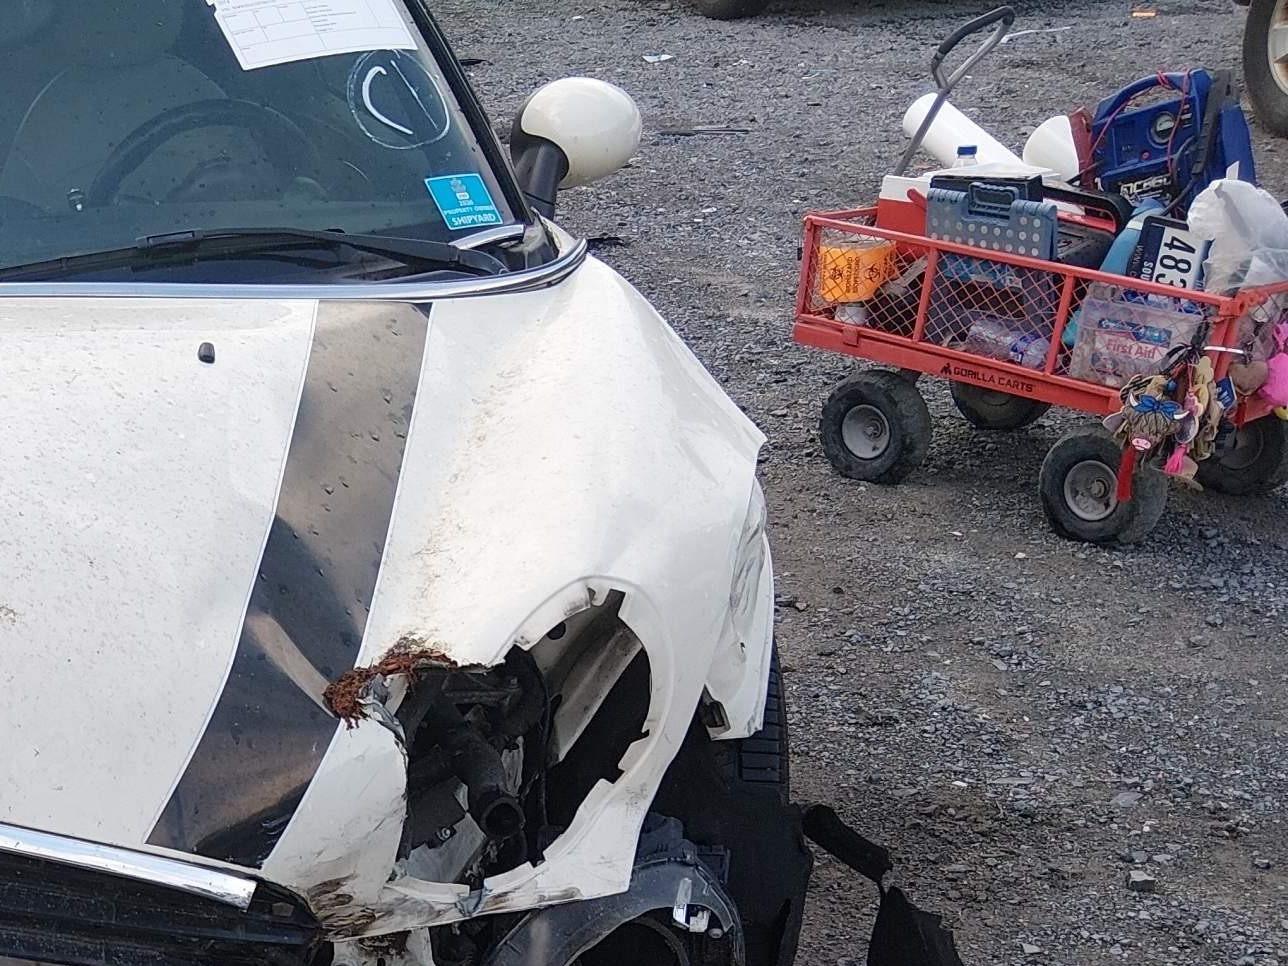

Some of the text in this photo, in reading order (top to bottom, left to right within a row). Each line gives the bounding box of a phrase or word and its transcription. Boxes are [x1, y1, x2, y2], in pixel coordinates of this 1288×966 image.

[452, 213, 496, 226] SHIPYARD
[1106, 340, 1156, 359] First Aid
[953, 367, 1033, 393] GORILLA CARTS
